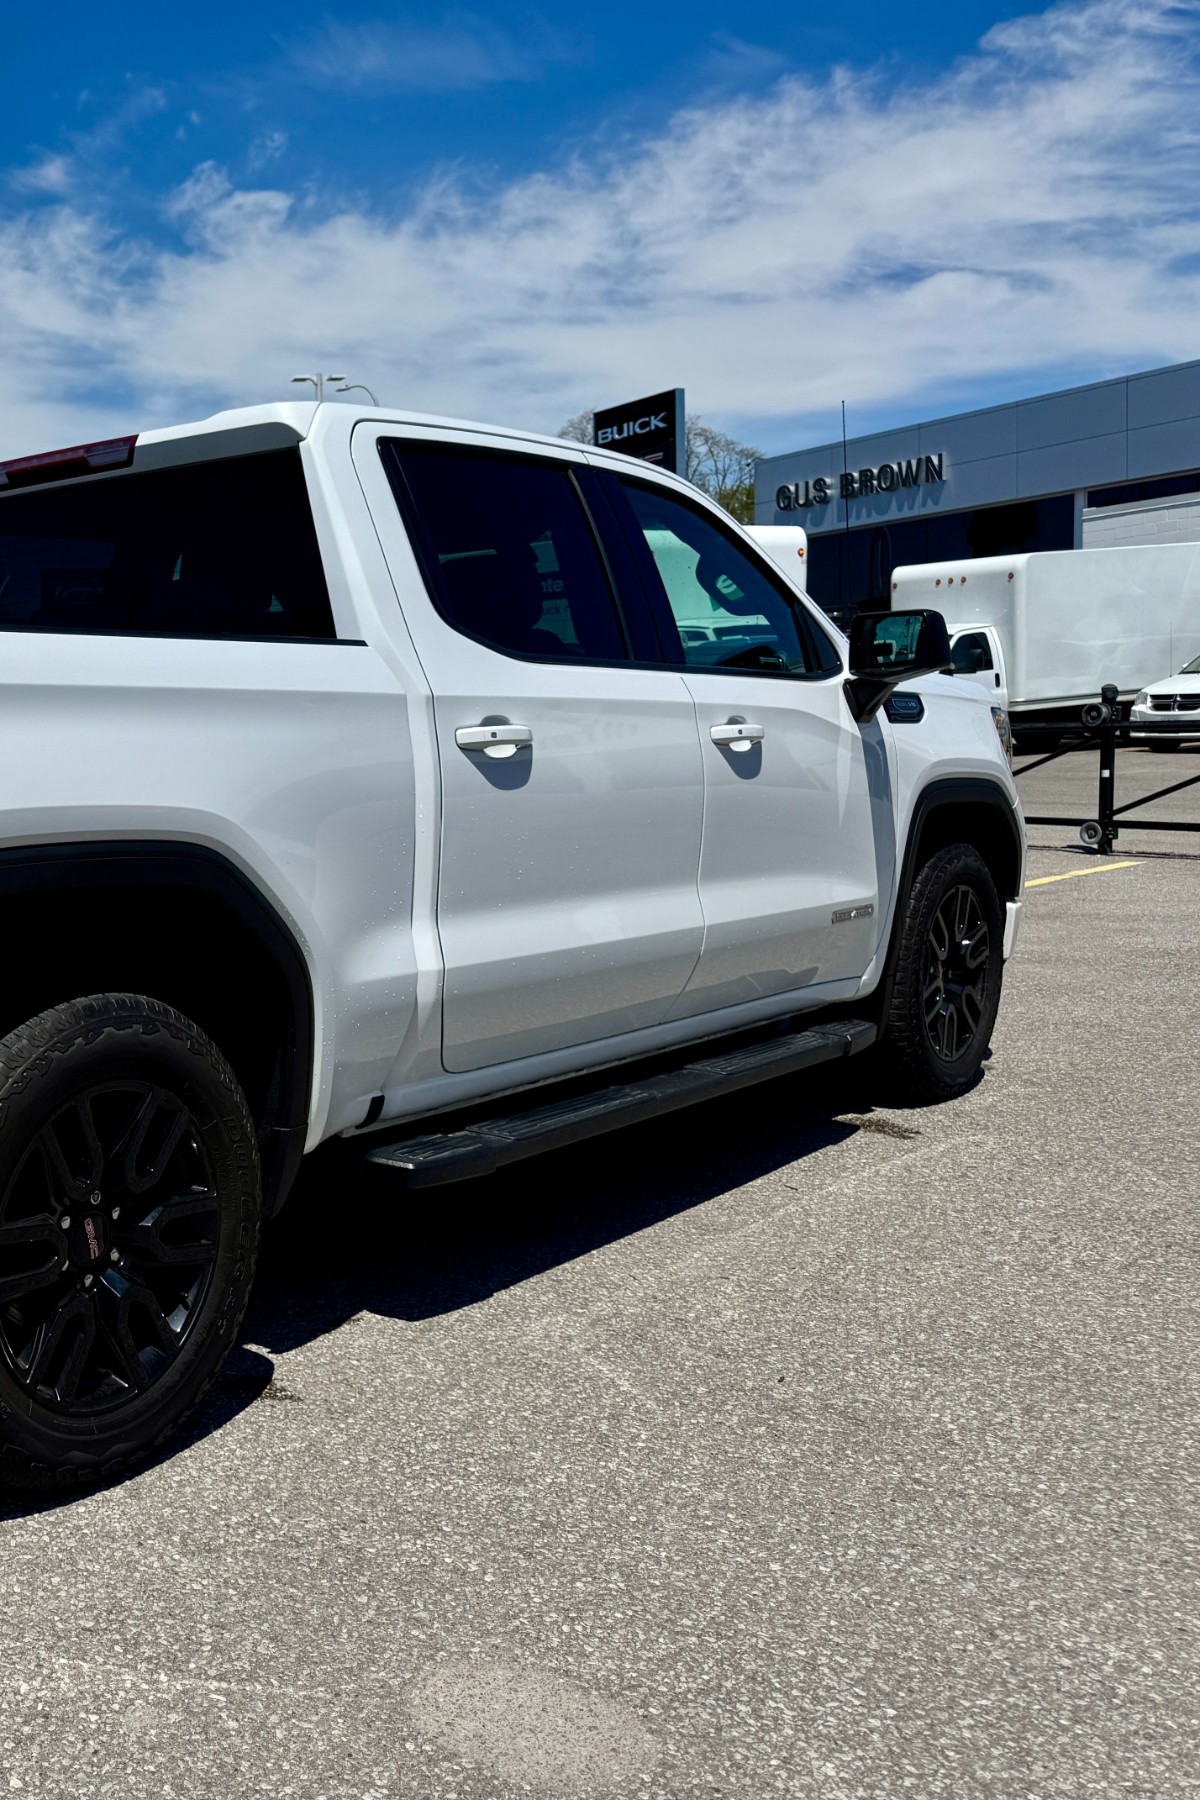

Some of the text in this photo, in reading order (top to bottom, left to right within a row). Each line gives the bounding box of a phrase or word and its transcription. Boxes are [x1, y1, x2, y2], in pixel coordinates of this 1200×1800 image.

[597, 411, 668, 445] BUICK
[776, 453, 945, 512] GUS BROWN
[84, 1218, 99, 1260] GMC
